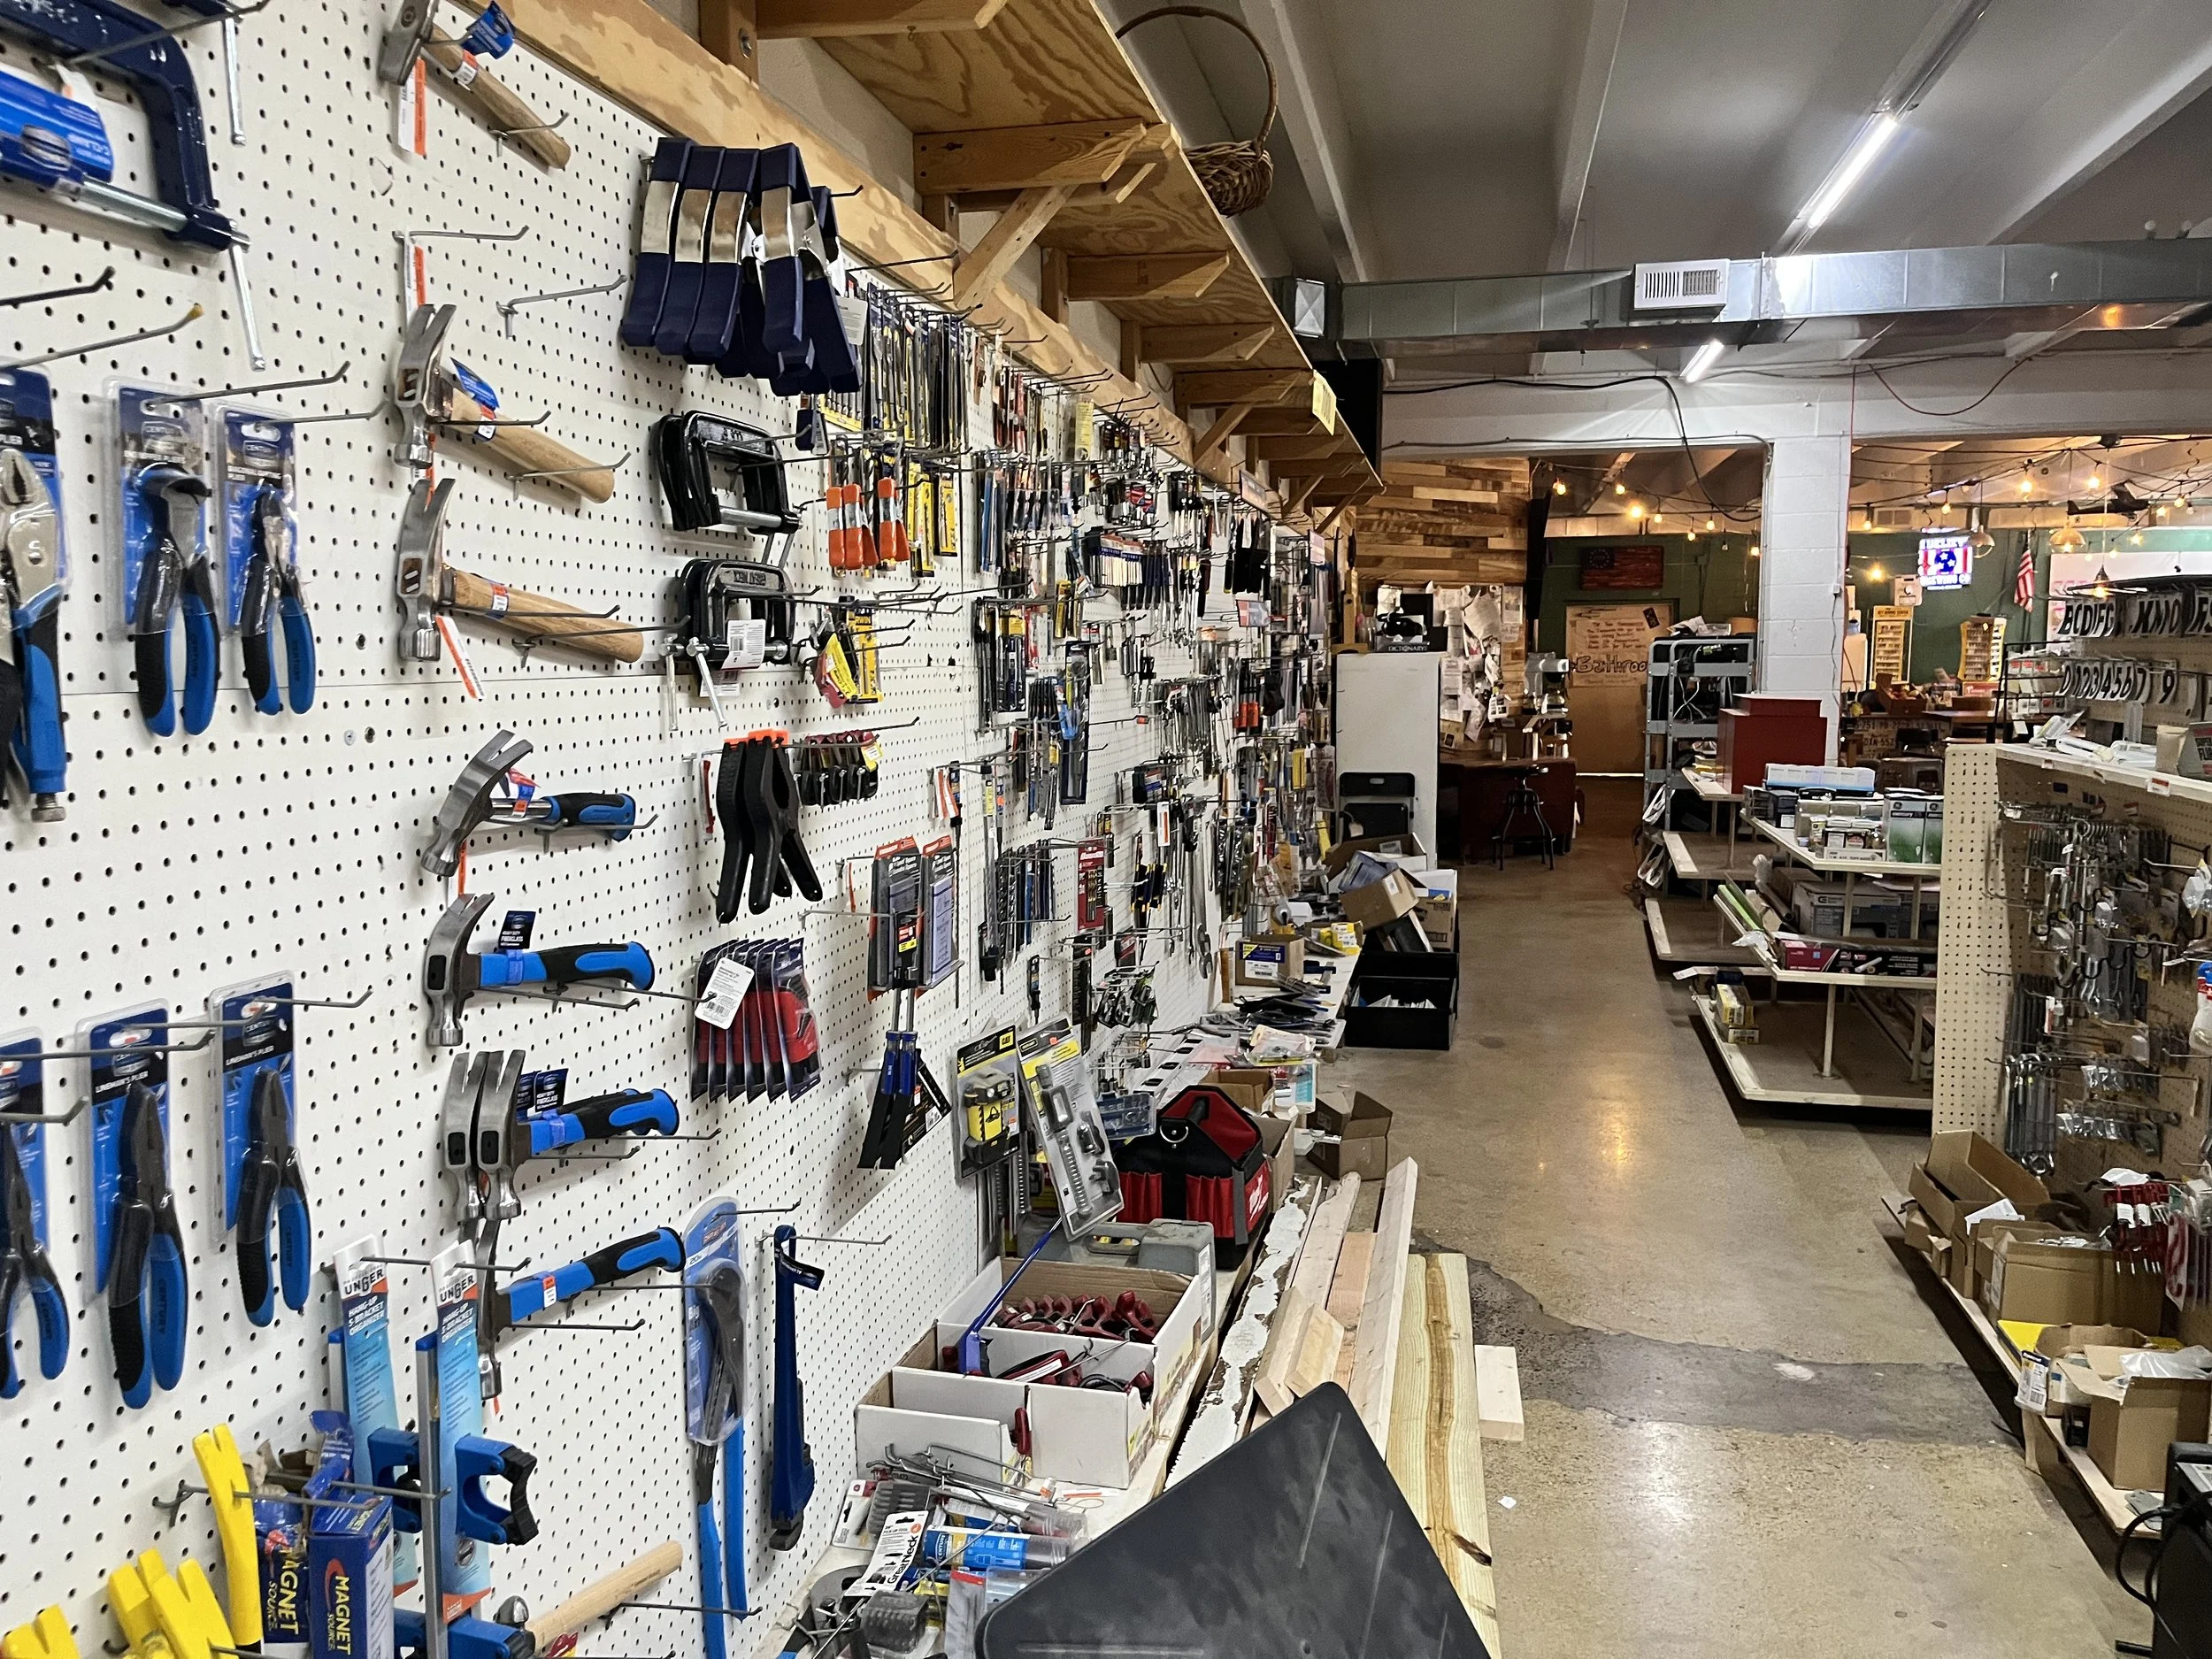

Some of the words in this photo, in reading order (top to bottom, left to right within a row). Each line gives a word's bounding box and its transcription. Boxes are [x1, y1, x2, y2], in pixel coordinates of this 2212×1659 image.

[1576, 654, 1648, 673] Bathroo
[257, 1045, 275, 1056] PLIER
[131, 1071, 150, 1083] PLIER
[343, 1268, 385, 1295] UNGER
[439, 1274, 475, 1302] UNGER
[157, 1278, 167, 1335] CENTURY
[348, 1296, 379, 1317] HANG-UP
[348, 1301, 384, 1327] S-BRACKET
[442, 1302, 469, 1324] HANG-UP
[334, 1575, 351, 1655] MAGNET
